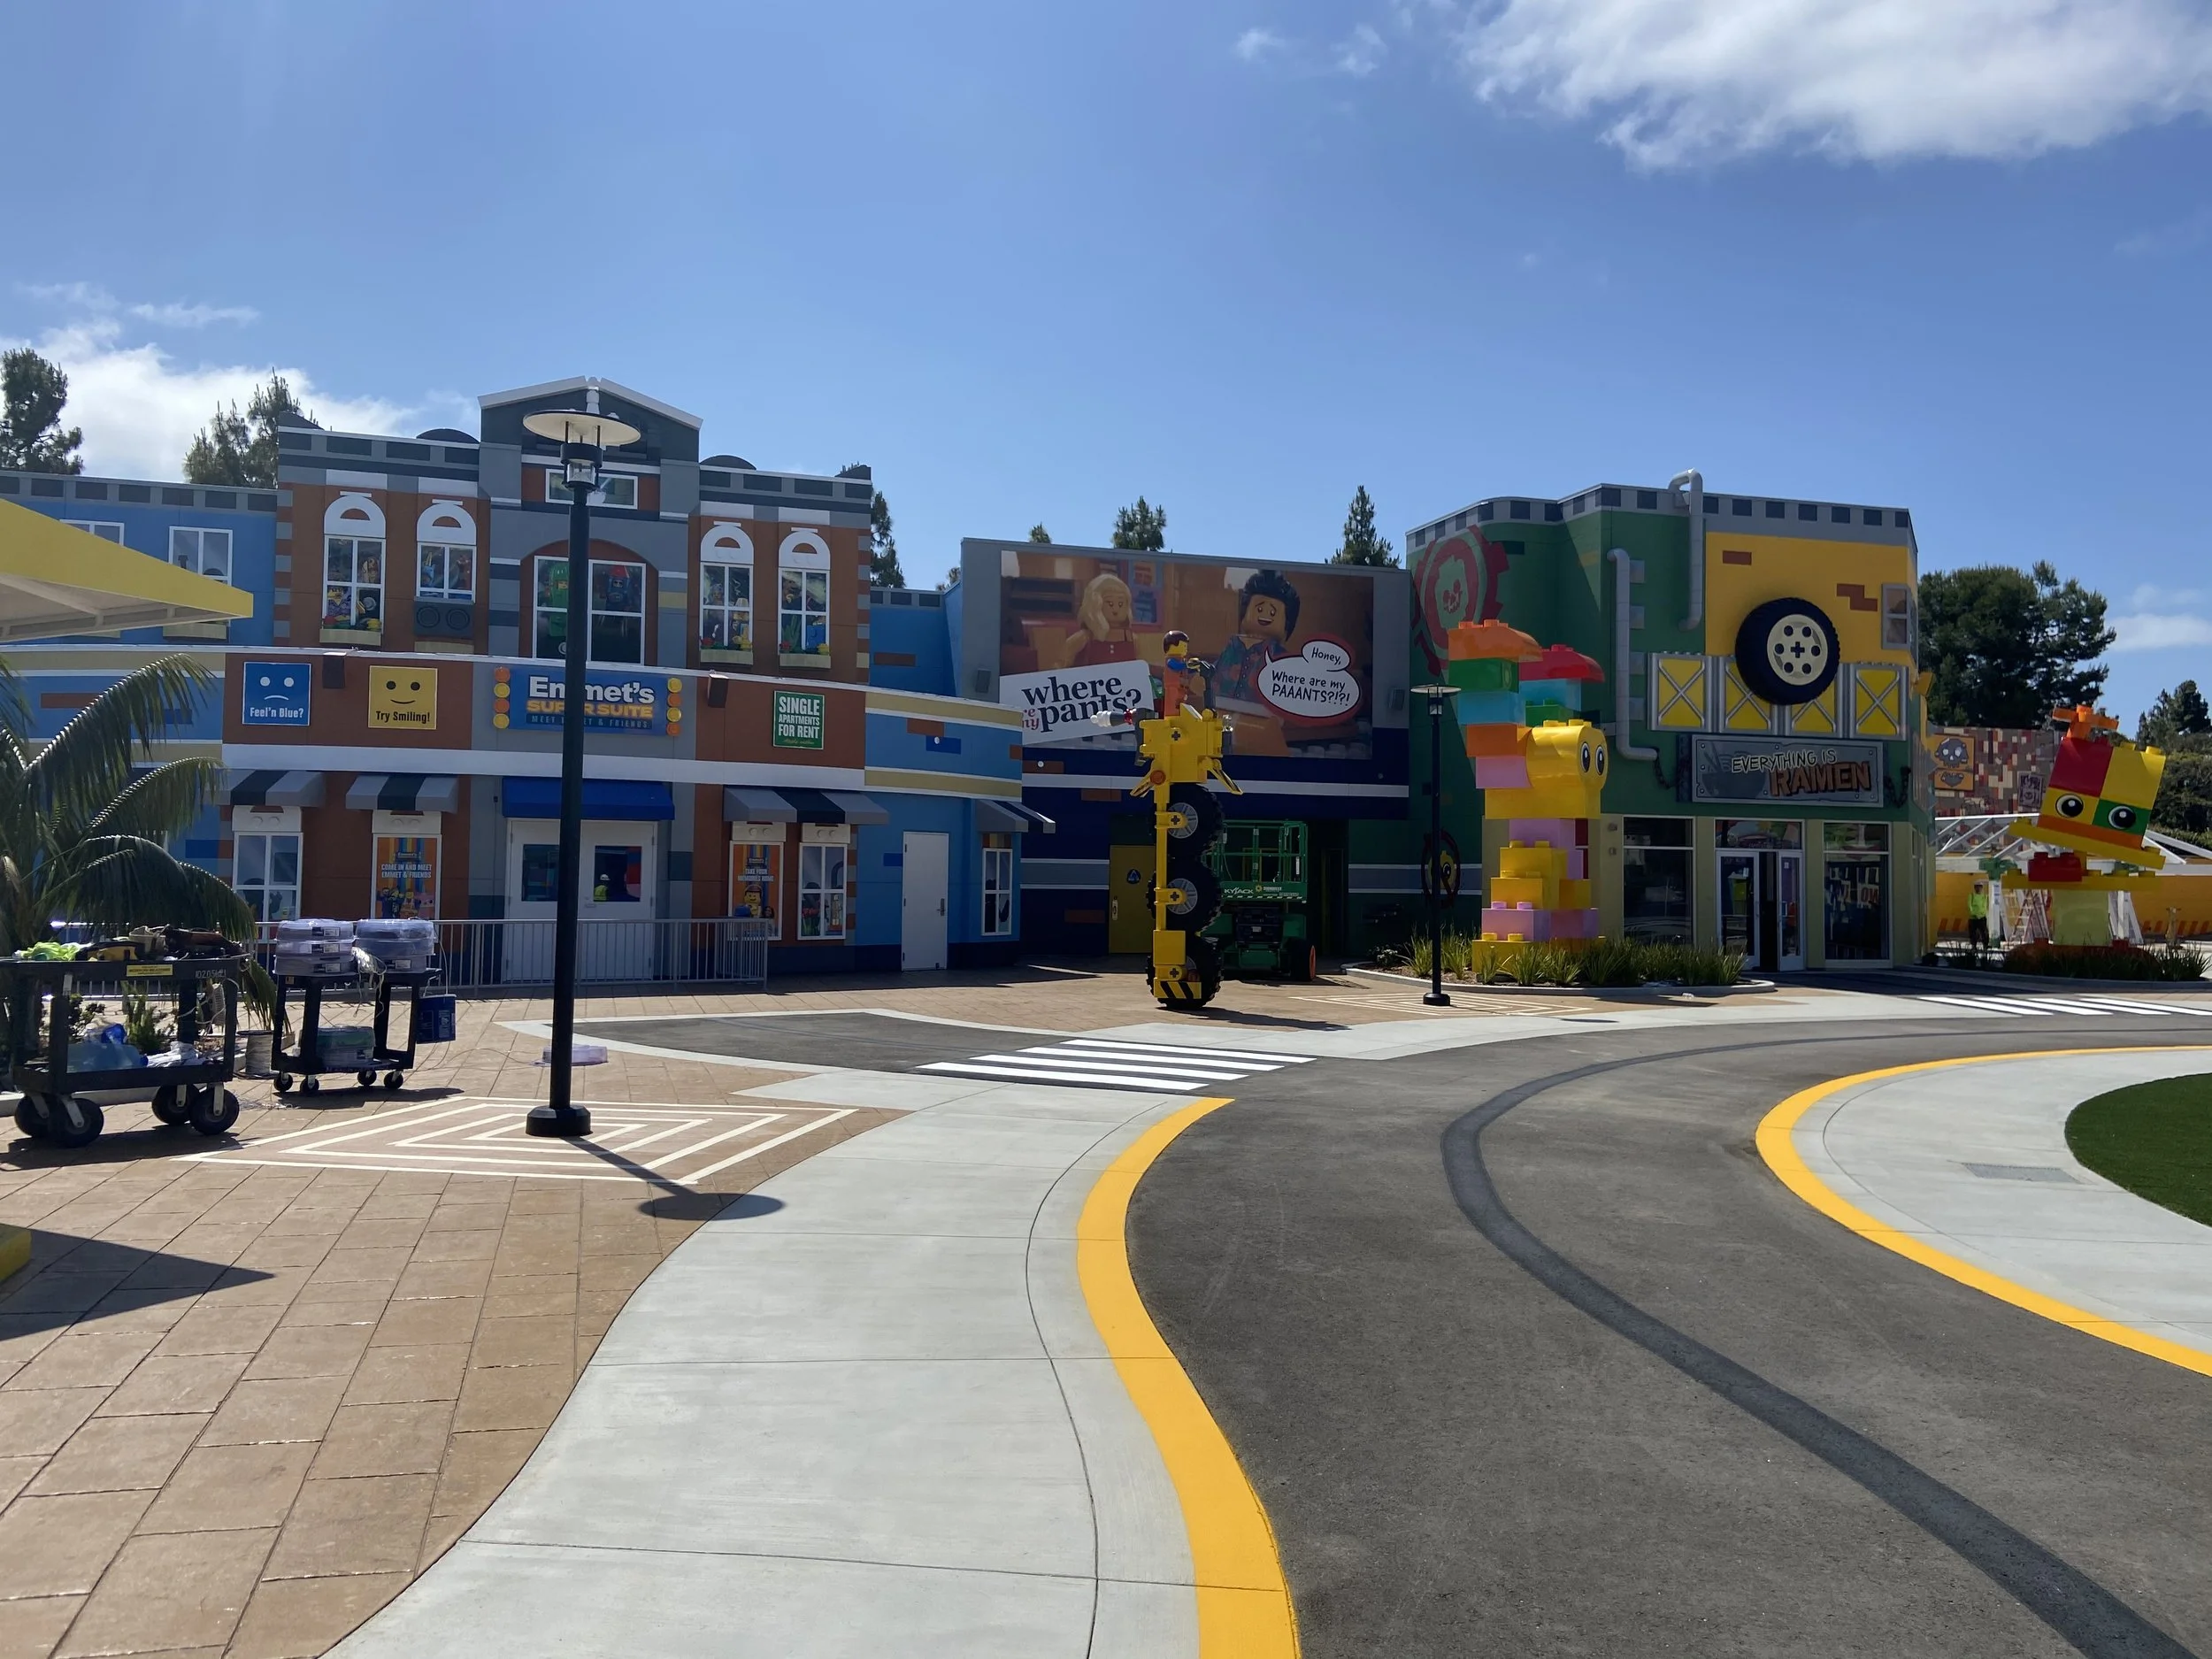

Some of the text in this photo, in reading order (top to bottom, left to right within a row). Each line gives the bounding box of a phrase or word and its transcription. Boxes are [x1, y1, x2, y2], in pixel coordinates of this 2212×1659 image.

[1311, 647, 1341, 665] Honey,
[1021, 676, 1123, 706] where
[1271, 670, 1346, 693] Where are my
[1271, 683, 1350, 706] PAAANTS?!?!
[250, 707, 304, 718] Feel'n Blue?
[526, 700, 653, 718] SUPR SUITE
[779, 695, 820, 716] SINGLE
[1037, 688, 1141, 733] pants?
[375, 710, 431, 725] Try Smiling!
[531, 715, 556, 724] MEET
[779, 714, 820, 726] APARTMENTS
[779, 724, 820, 739] FOR RENT
[1731, 749, 1837, 773] EVERYTHING IS
[1770, 761, 1871, 796] RAMEN
